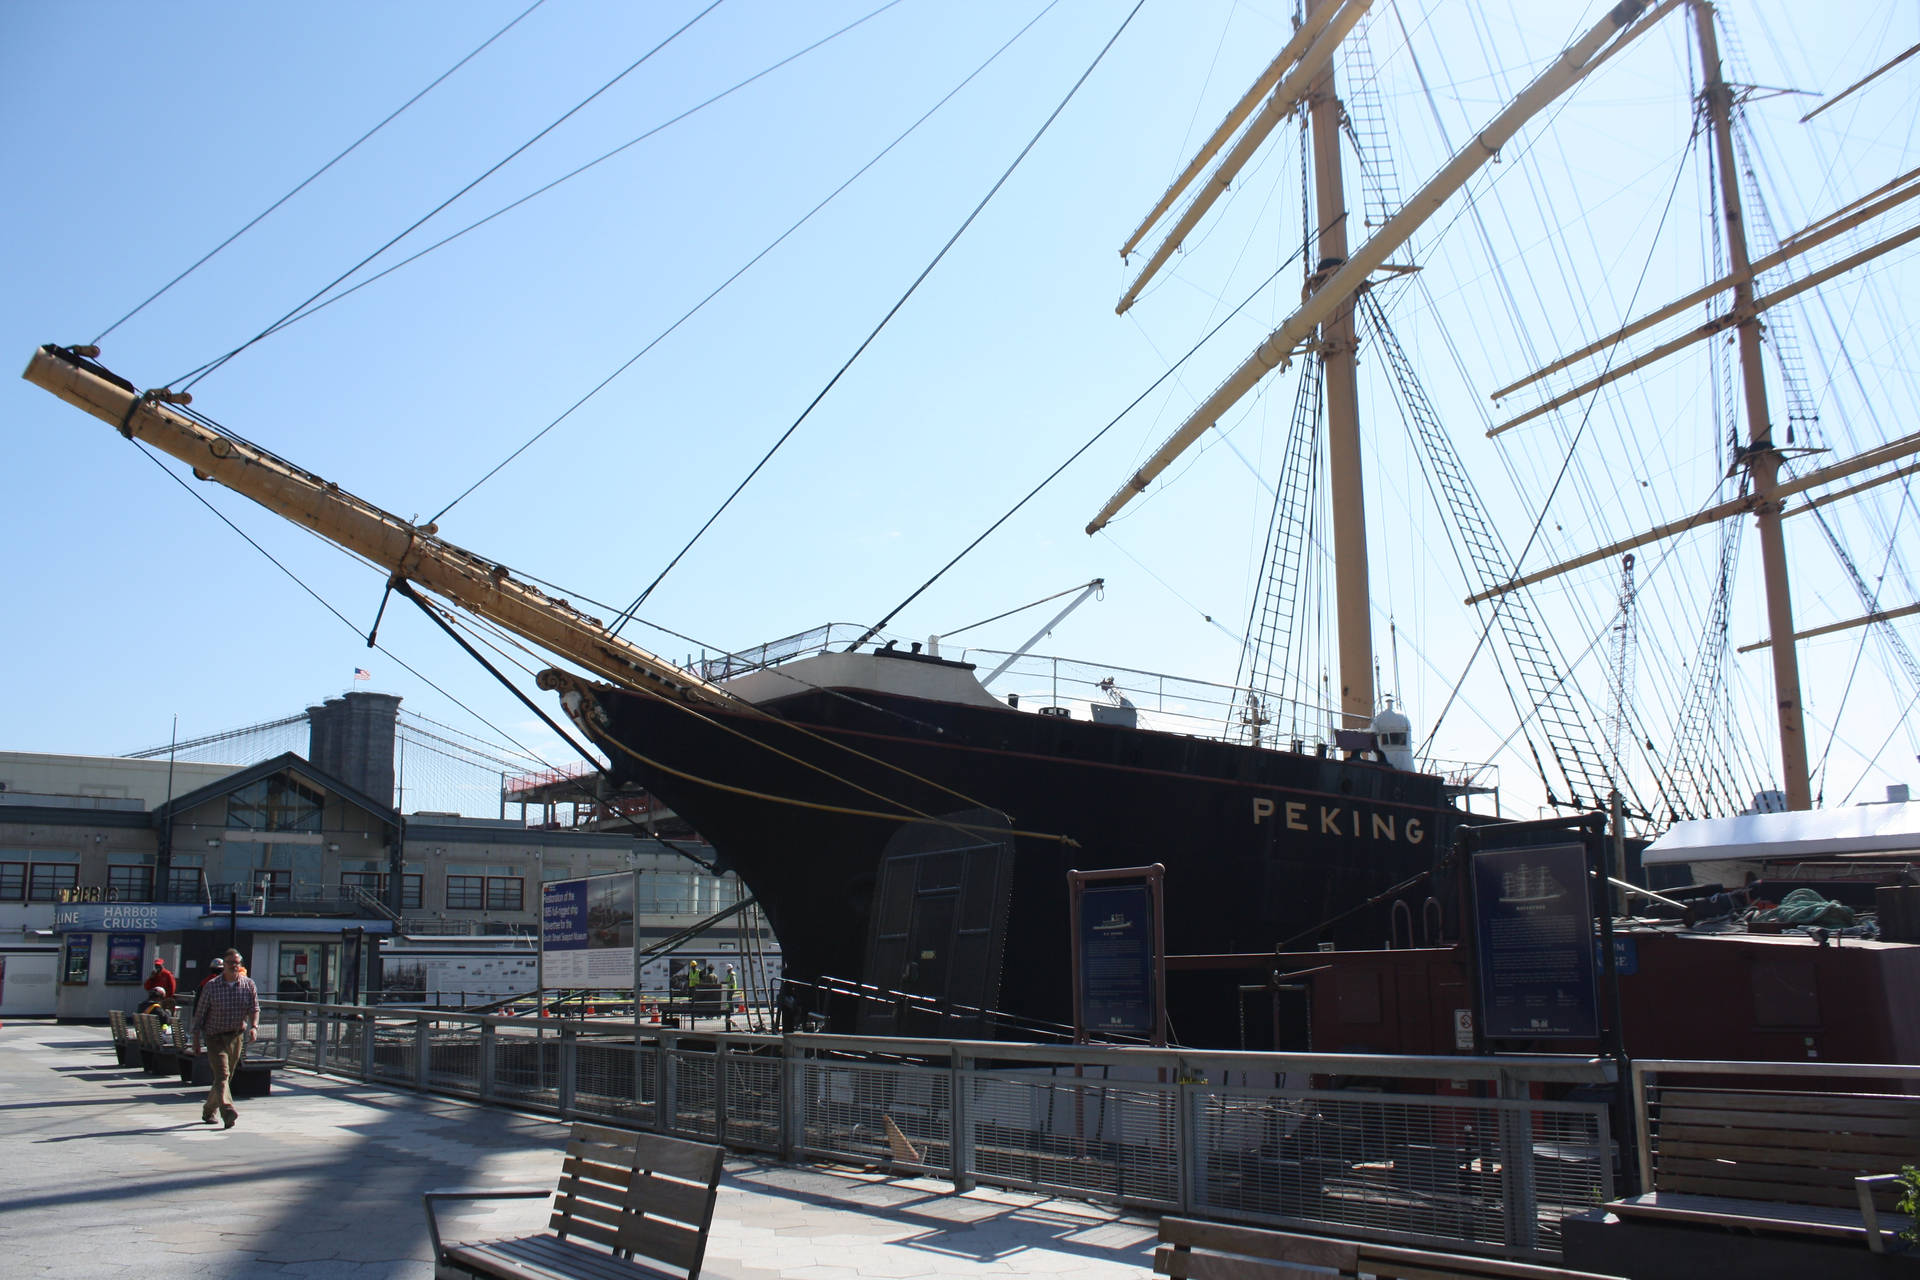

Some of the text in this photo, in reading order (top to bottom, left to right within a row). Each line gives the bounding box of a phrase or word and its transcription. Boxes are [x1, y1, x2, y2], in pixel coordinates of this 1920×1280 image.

[1252, 796, 1426, 845] PEKING
[71, 886, 101, 902] PIER
[56, 912, 80, 925] LINE
[103, 907, 158, 917] HARBOR
[103, 918, 158, 929] CRUISES
